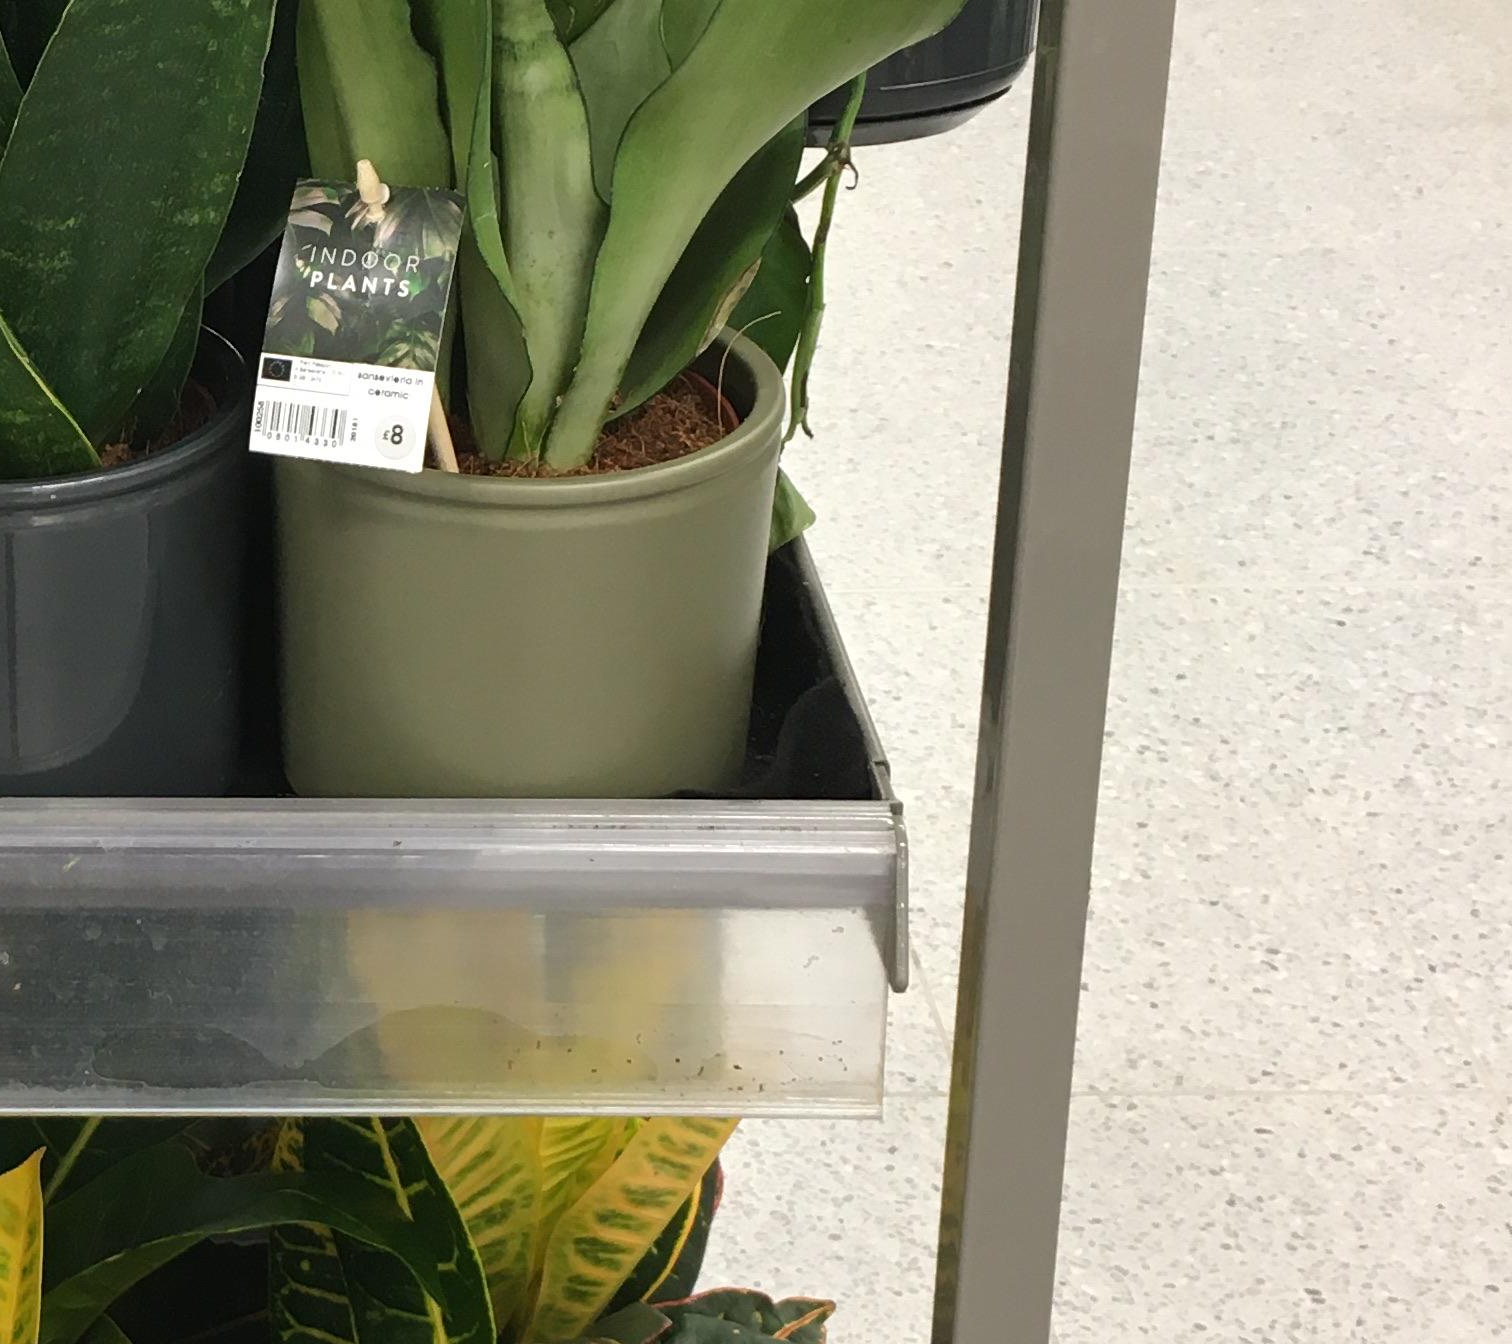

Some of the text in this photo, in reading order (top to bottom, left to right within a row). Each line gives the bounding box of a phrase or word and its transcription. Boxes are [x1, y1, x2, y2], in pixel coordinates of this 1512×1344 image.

[310, 245, 421, 274] INDOOR
[309, 270, 411, 298] PLANTS
[367, 388, 409, 400] ceramic
[382, 423, 404, 446] £8
